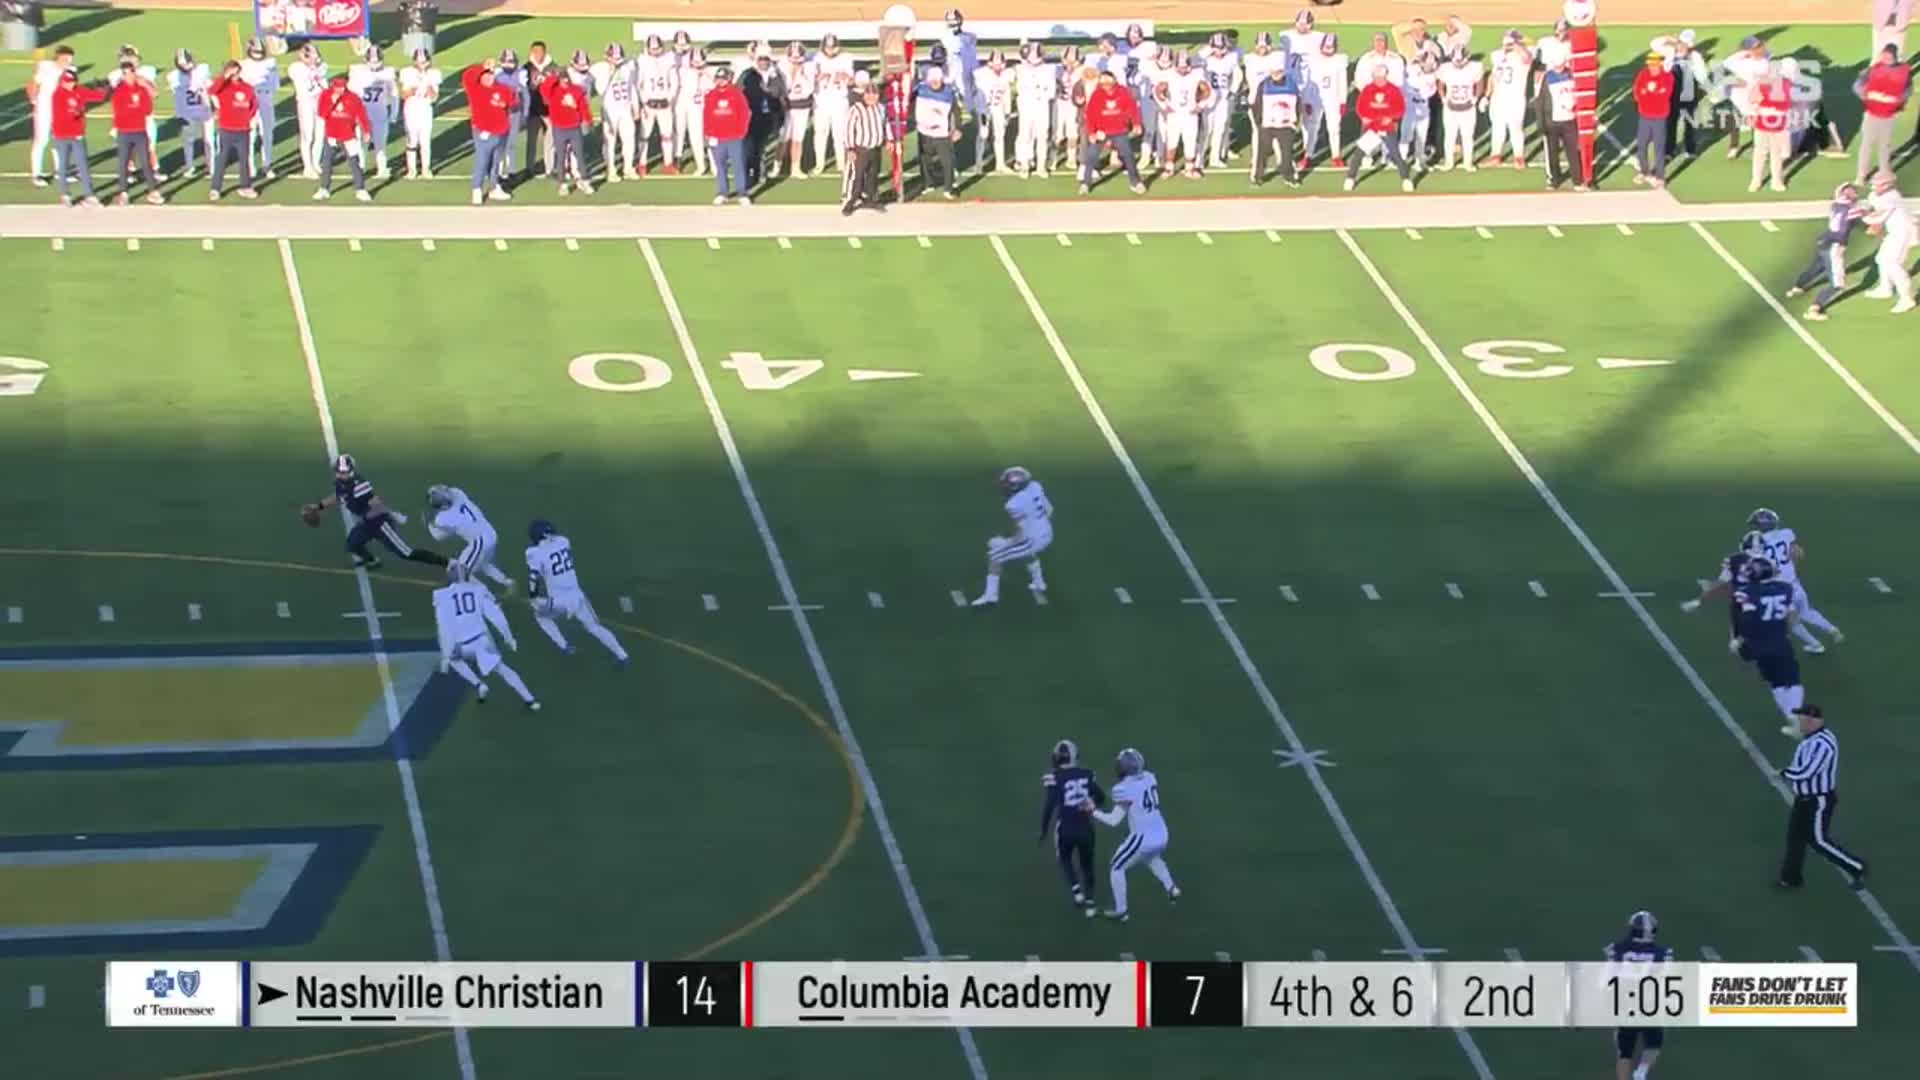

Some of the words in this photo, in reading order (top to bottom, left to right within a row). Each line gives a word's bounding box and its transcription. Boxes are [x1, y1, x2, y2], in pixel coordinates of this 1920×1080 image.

[460, 503, 477, 523] 7
[550, 551, 575, 576] 22
[453, 591, 476, 616] 10
[1760, 594, 1786, 621] 75
[1063, 778, 1089, 806] 25
